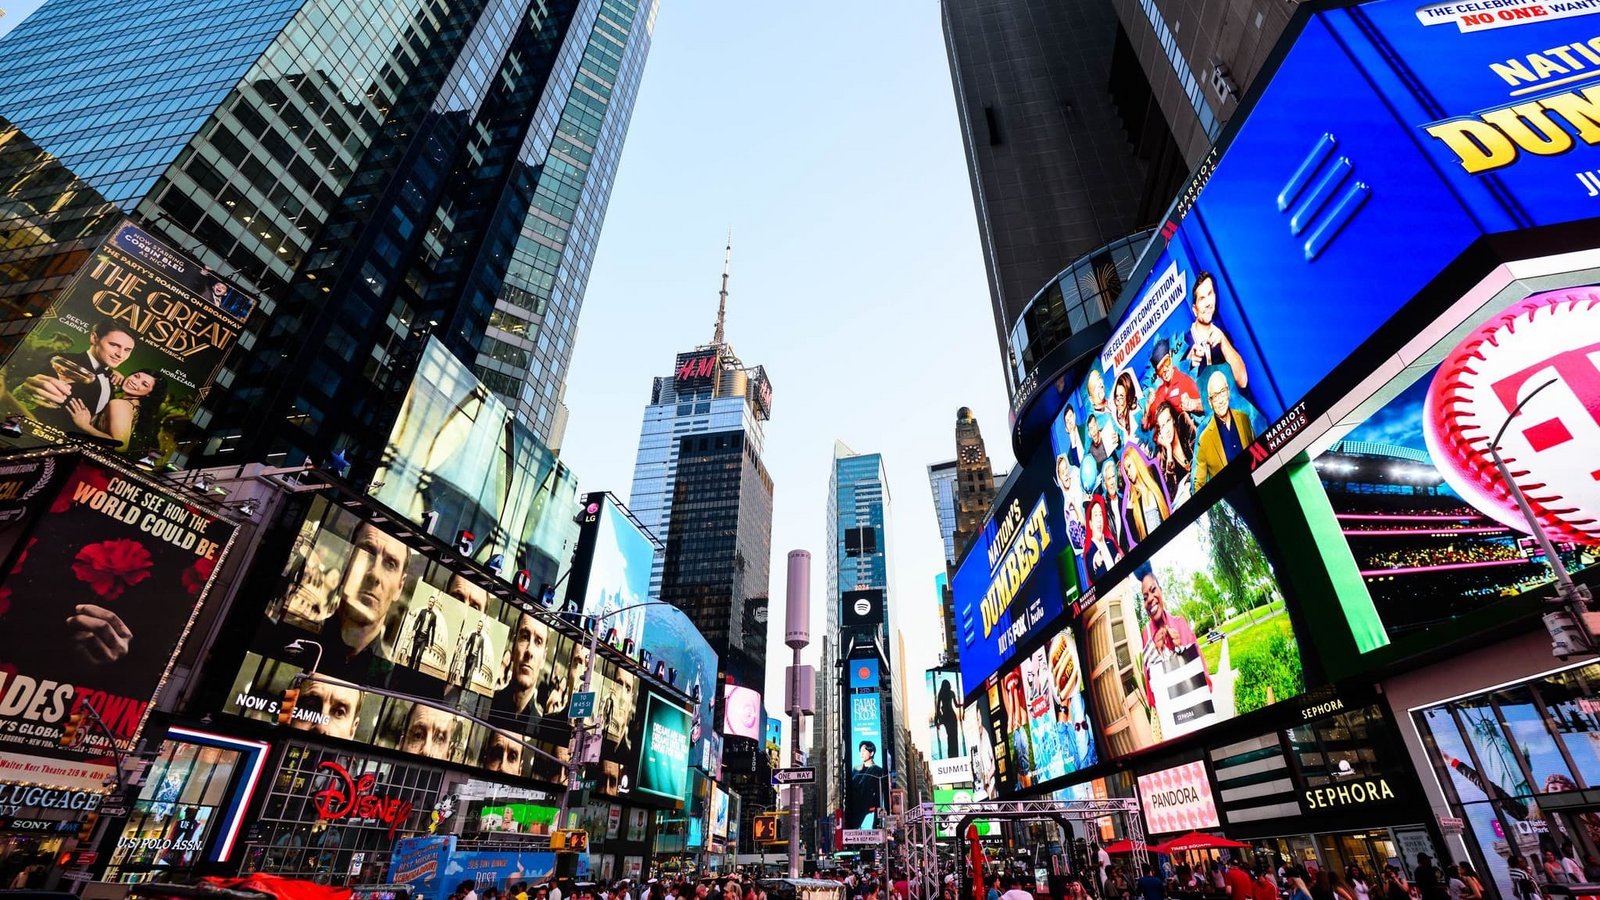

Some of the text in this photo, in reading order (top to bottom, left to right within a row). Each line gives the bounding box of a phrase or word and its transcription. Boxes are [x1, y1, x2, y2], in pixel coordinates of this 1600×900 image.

[1425, 5, 1455, 18] THE
[1460, 11, 1497, 27] NO
[1499, 5, 1549, 23] ONE
[1177, 147, 1217, 212] MARRIOTT
[125, 234, 185, 273] CORBIN BLEU
[133, 232, 185, 267] NOW STARRING
[138, 250, 167, 269] AS NICK
[103, 245, 242, 330] THE PARTY'S ROARING ON BROADWAY
[90, 260, 237, 350] THE GREAT
[1103, 273, 1176, 362] THE CELEBRITY COMPETITION
[59, 317, 89, 334] CARNEY
[66, 313, 90, 328] REEVE
[92, 290, 210, 357] GATSBY
[1114, 283, 1183, 368] NO ONE WANTS TO WIN
[145, 339, 160, 349] NEW
[160, 346, 186, 363] MUSICAL
[160, 368, 196, 389] NOBLEZADA
[175, 369, 187, 378] EVA
[677, 355, 716, 380] H&M
[1265, 401, 1306, 441] MARRIOTT
[1269, 416, 1306, 450] MARQUIS
[107, 476, 211, 534] COME SEE HOW THE
[73, 481, 219, 560] WORLD COULD BE
[988, 498, 1022, 569] NATION'S
[980, 499, 1051, 640] DUMBEST
[1012, 613, 1027, 642] FOX
[1030, 607, 1044, 626] hulu
[235, 693, 330, 726] NOW SEAMING
[1302, 699, 1344, 720] SEPHORA
[19, 724, 63, 739] GLOBA
[0, 759, 23, 770] Walter
[24, 763, 40, 772] Kerr
[41, 765, 66, 776] Theatre
[778, 772, 791, 780] ONE
[0, 784, 102, 811] LUGGAGE
[1151, 786, 1200, 810] PANDORA
[1305, 779, 1395, 810] SEPHORA
[11, 820, 52, 830] SONY
[140, 838, 171, 850] POLO
[171, 840, 203, 851] ASSN.
